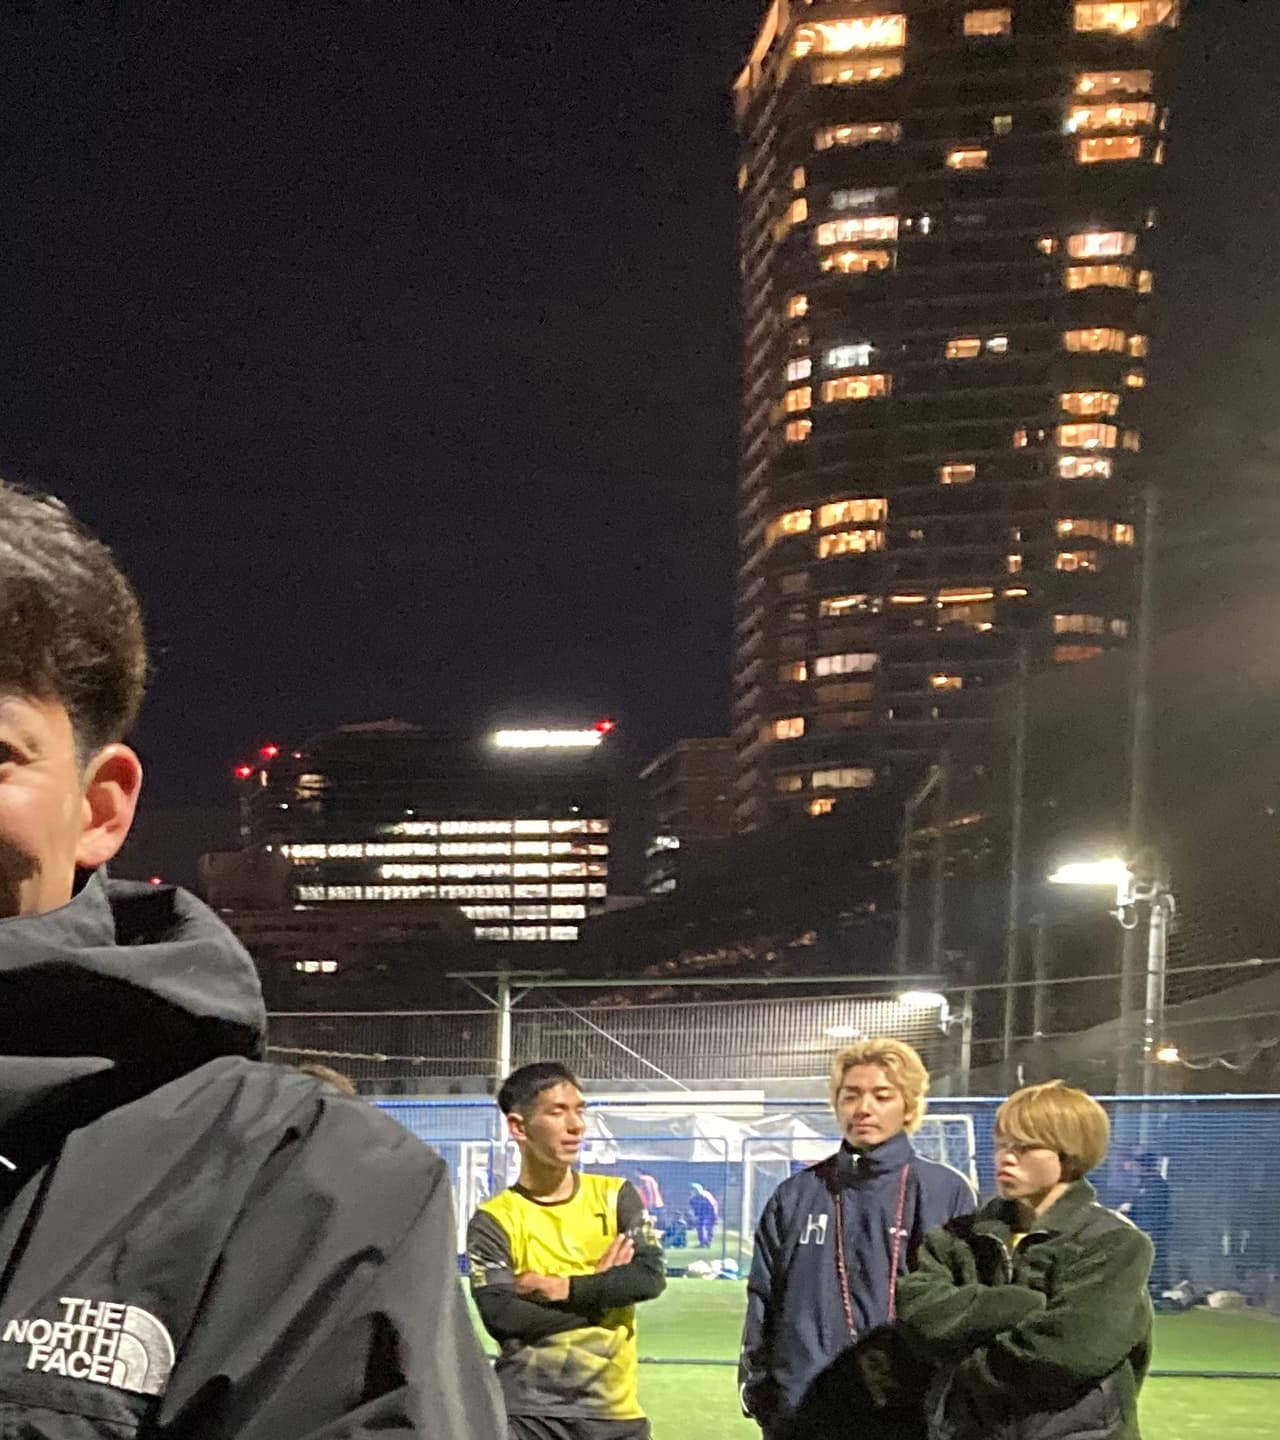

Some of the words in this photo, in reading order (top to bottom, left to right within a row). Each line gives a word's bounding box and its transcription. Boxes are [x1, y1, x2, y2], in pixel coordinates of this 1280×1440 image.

[60, 1297, 127, 1331] THE
[2, 1318, 121, 1359] NORTH
[26, 1344, 115, 1385] FACE
